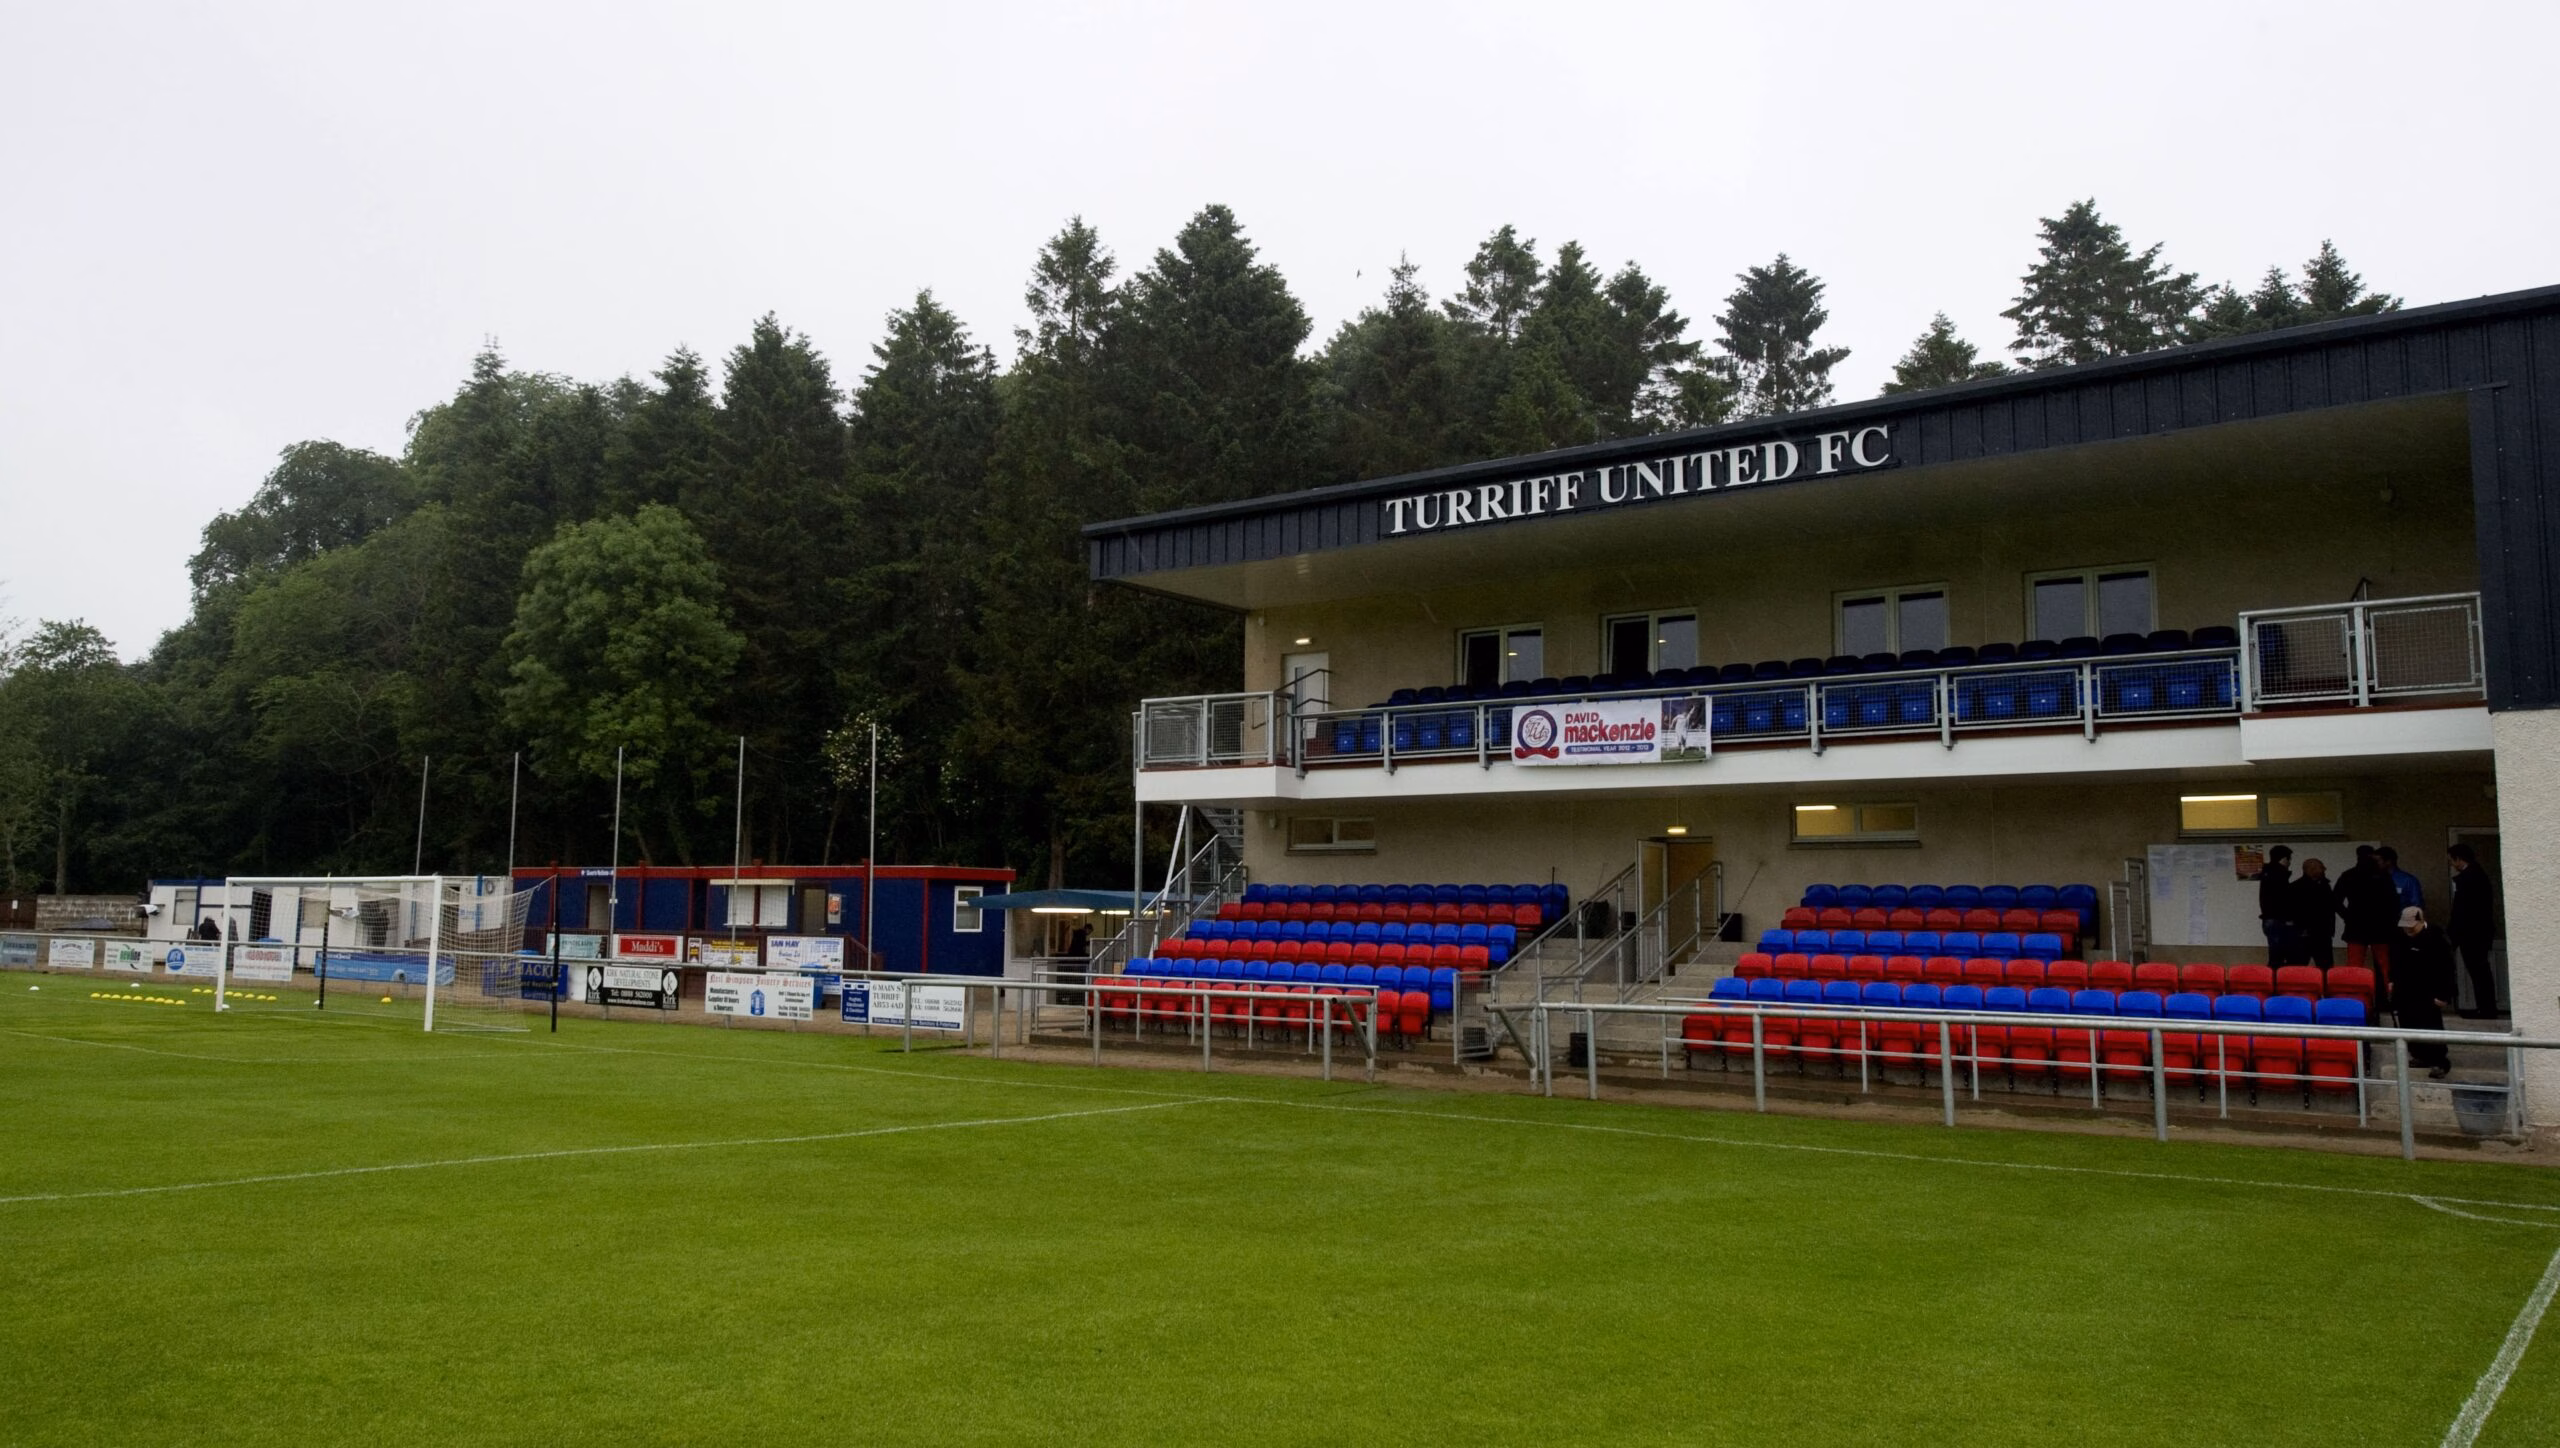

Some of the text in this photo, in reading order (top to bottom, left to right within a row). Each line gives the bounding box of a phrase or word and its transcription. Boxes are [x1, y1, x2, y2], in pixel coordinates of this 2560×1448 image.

[1386, 425, 1889, 534] TURRIFF UNITED FC
[1566, 712, 1599, 724] DAVID
[1564, 718, 1656, 743] mackenzie
[632, 941, 663, 952] Maddi's
[606, 968, 659, 980] KIRK NATURAL STONE
[614, 978, 651, 988] DEVELOPMENTS
[588, 988, 600, 999] kirk
[897, 985, 922, 993] STET
[663, 994, 676, 1005] kirk
[873, 993, 900, 1001] TURRIFF
